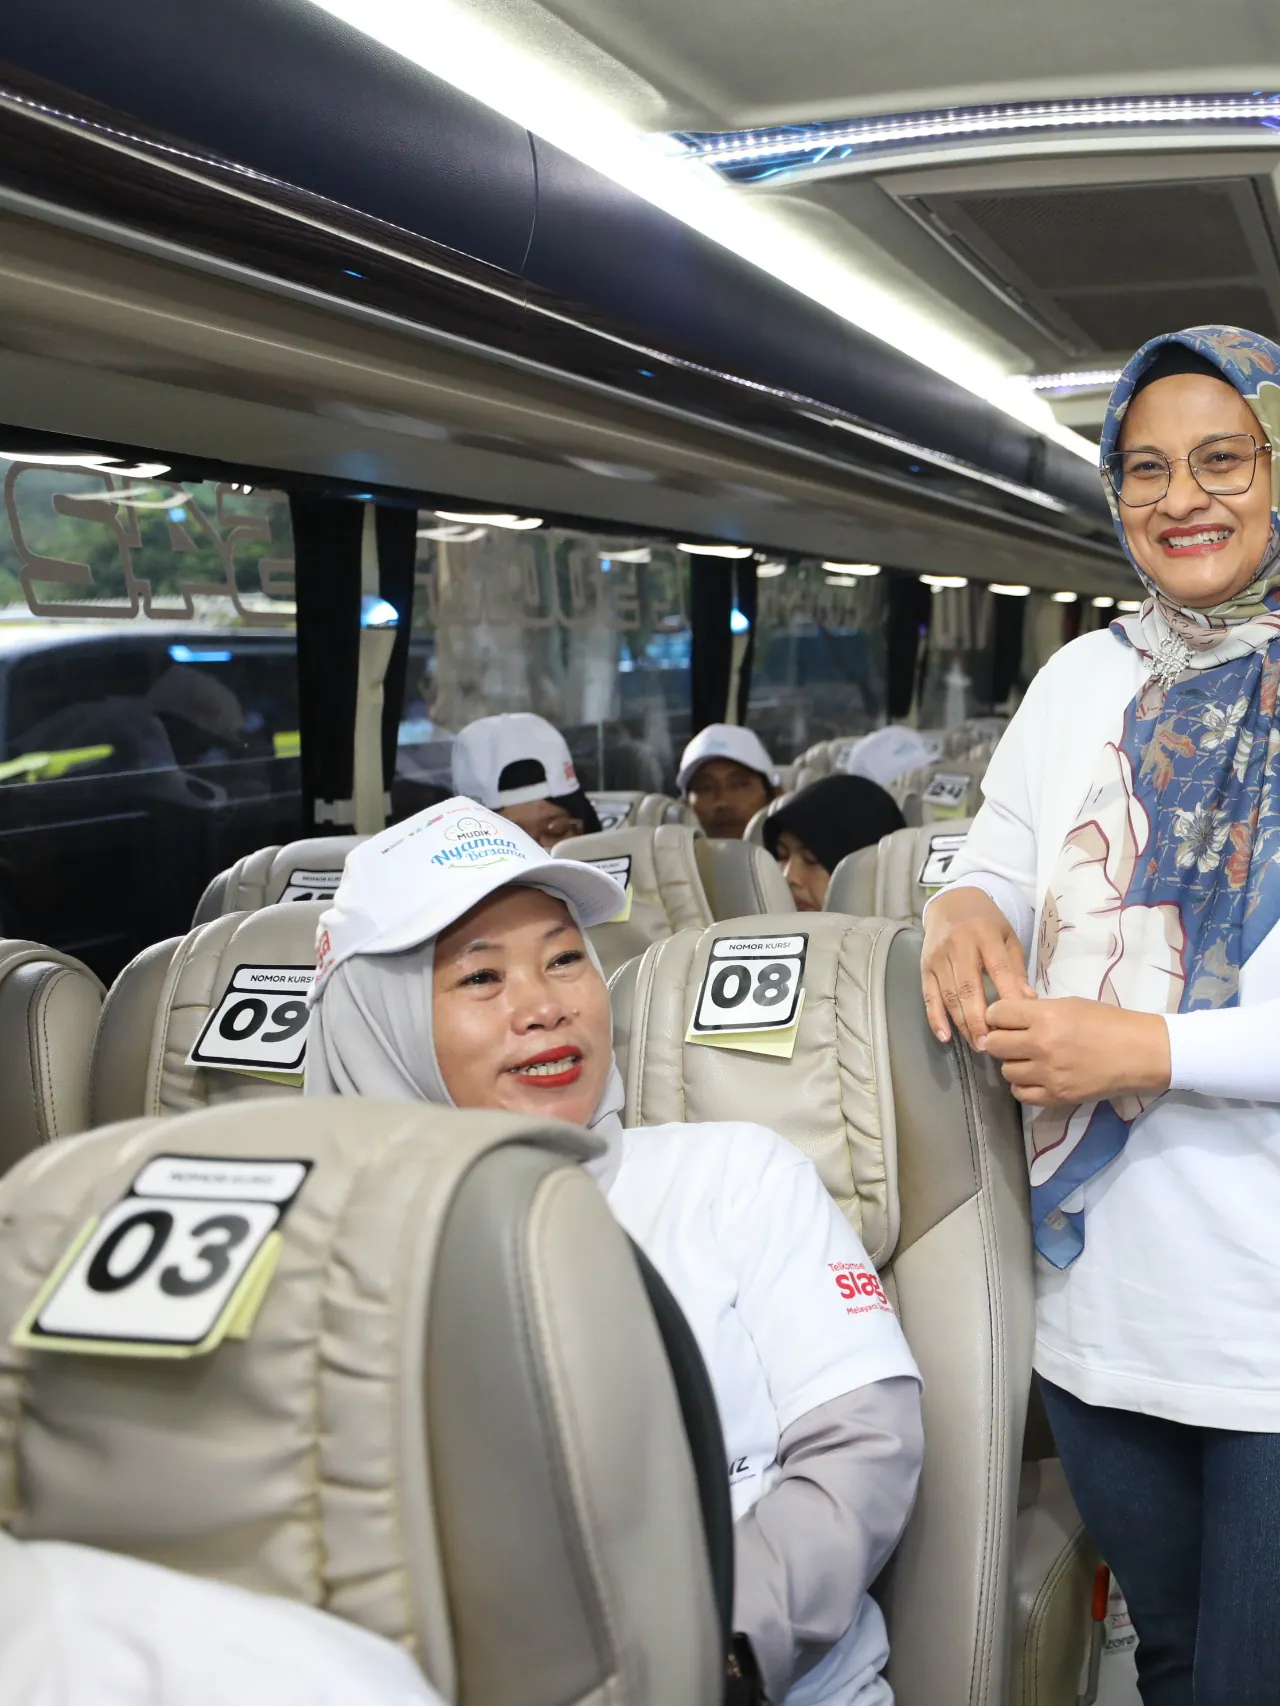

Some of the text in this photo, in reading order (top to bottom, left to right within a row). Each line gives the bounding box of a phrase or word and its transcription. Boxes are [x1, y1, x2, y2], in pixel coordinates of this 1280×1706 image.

[457, 829, 491, 841] MUDIK
[431, 838, 519, 867] Nyaman
[465, 847, 527, 862] Bersama
[250, 974, 286, 983] NOMOR
[711, 963, 792, 1009] 08
[219, 998, 310, 1043] 09
[86, 1210, 251, 1298] 03
